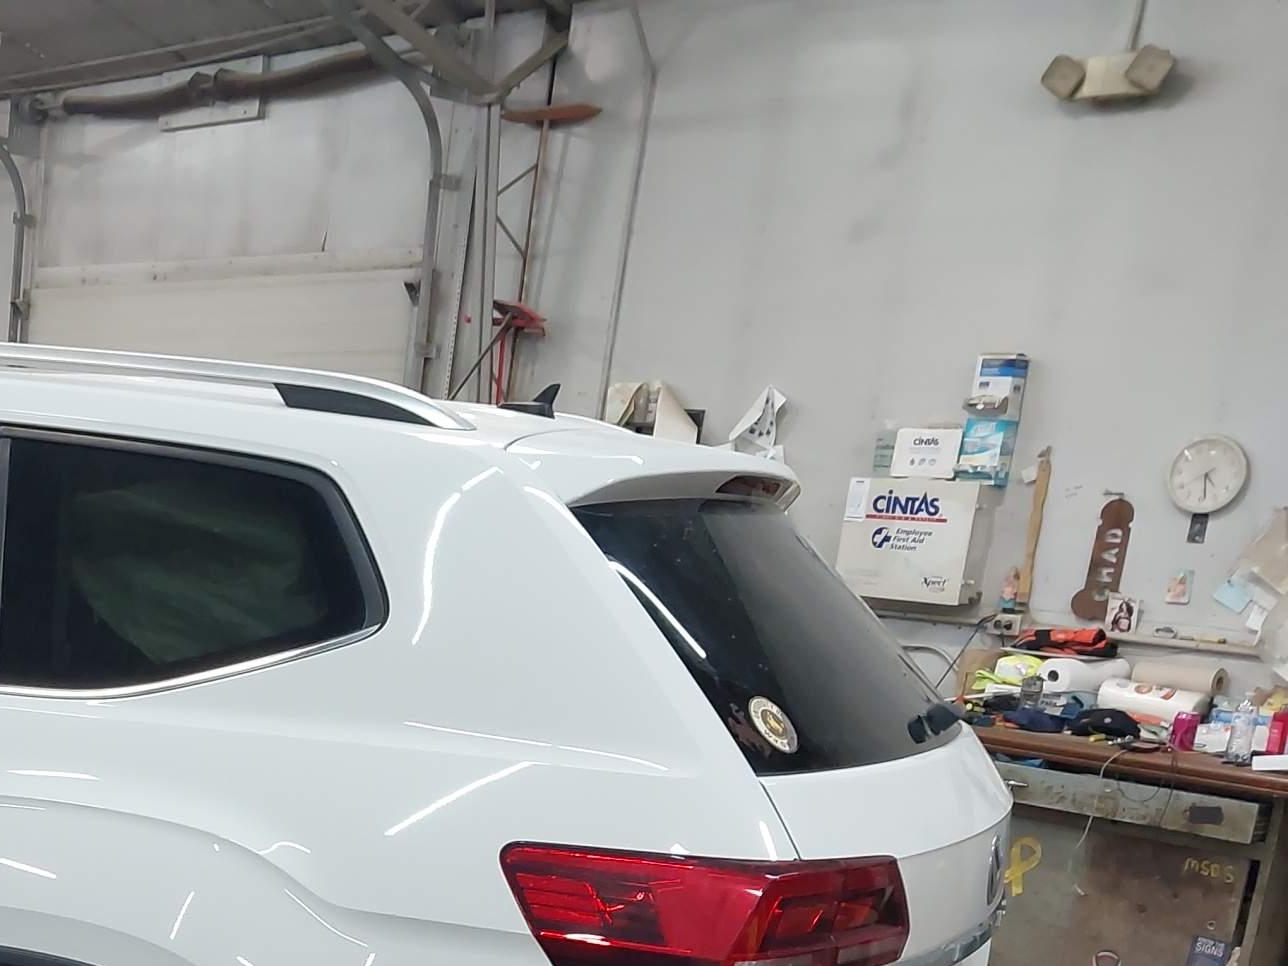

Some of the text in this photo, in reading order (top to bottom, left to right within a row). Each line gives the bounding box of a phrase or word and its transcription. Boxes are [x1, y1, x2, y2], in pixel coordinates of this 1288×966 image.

[872, 489, 941, 517] CINTAS
[895, 528, 933, 538] Employee
[892, 536, 910, 544] First
[1195, 942, 1225, 958] SIGNS
